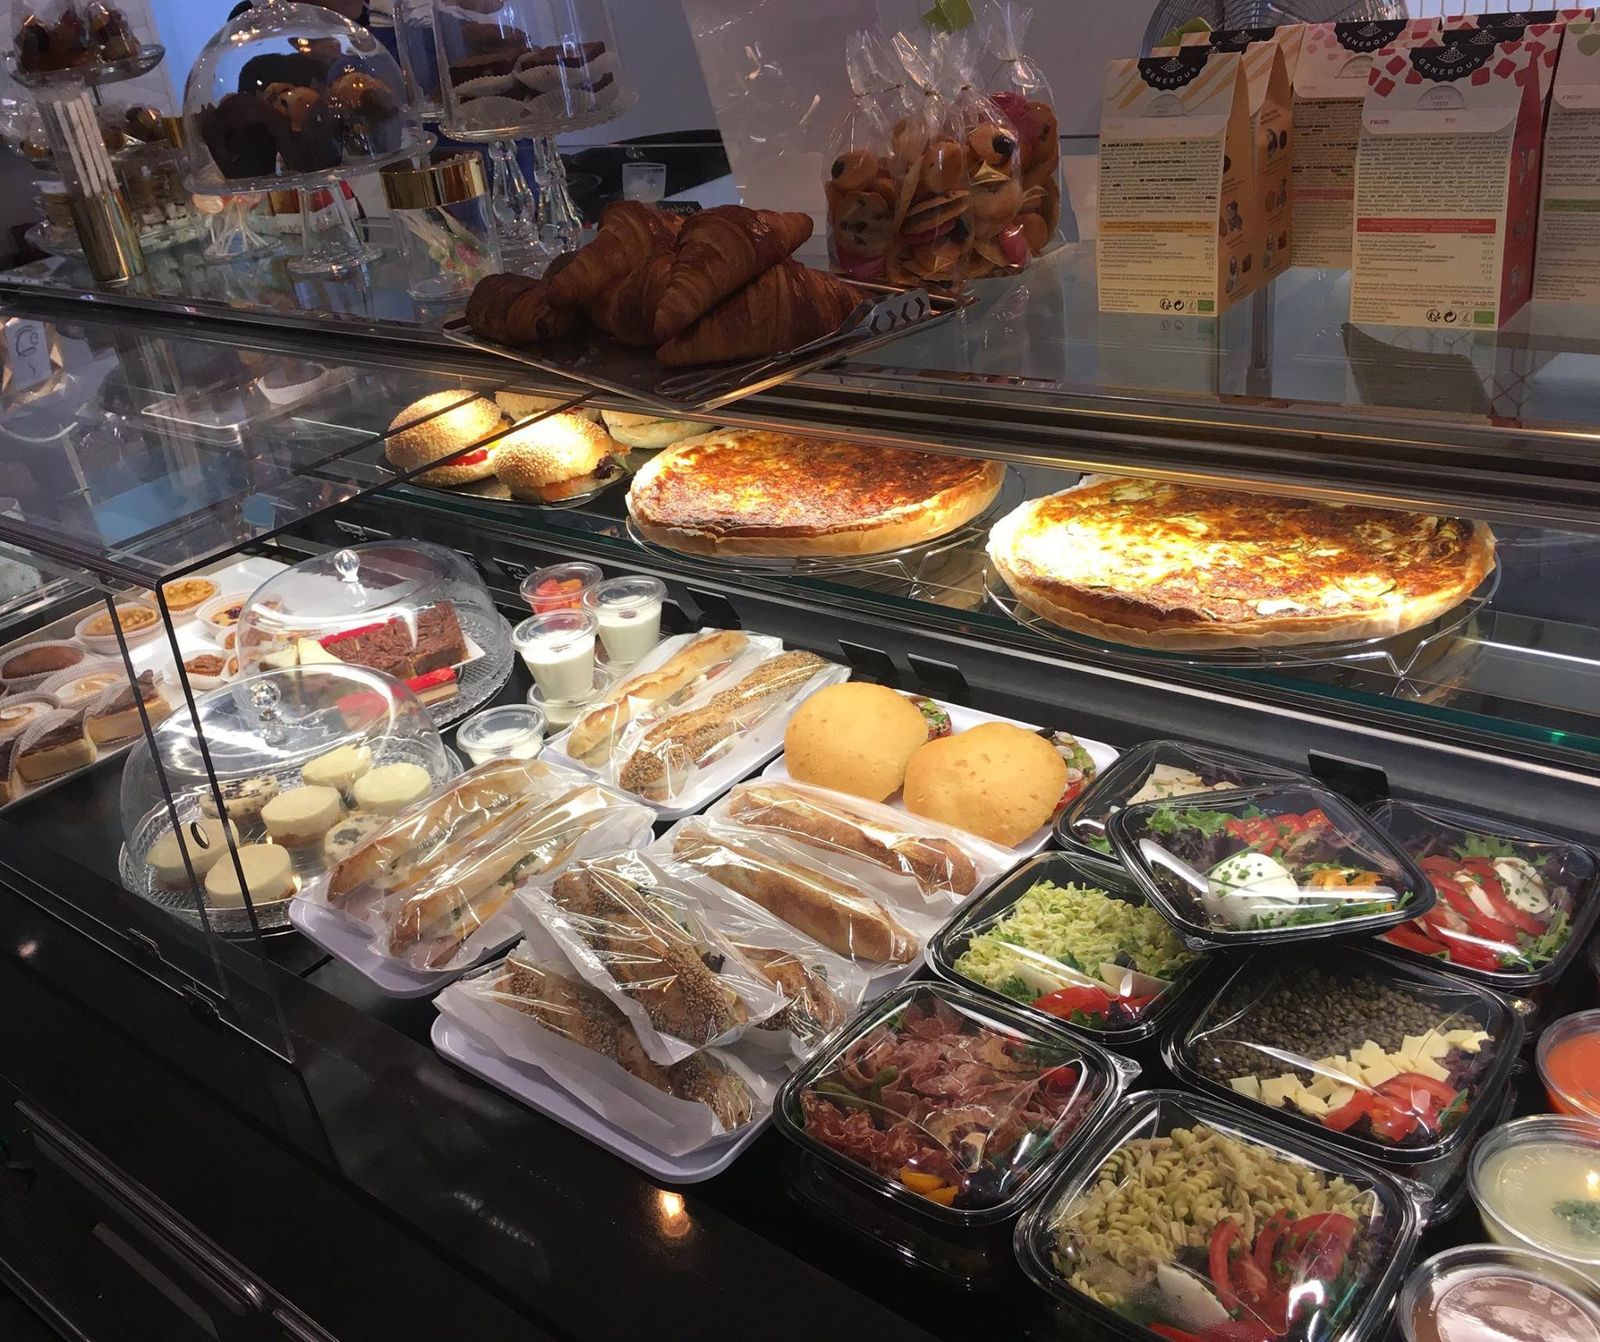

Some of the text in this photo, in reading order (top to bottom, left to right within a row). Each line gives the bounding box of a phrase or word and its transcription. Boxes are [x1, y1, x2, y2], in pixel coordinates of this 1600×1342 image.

[1343, 31, 1395, 47] GENEROUS
[1418, 57, 1481, 76] GENEROUS
[1145, 67, 1197, 84] GENEROUS
